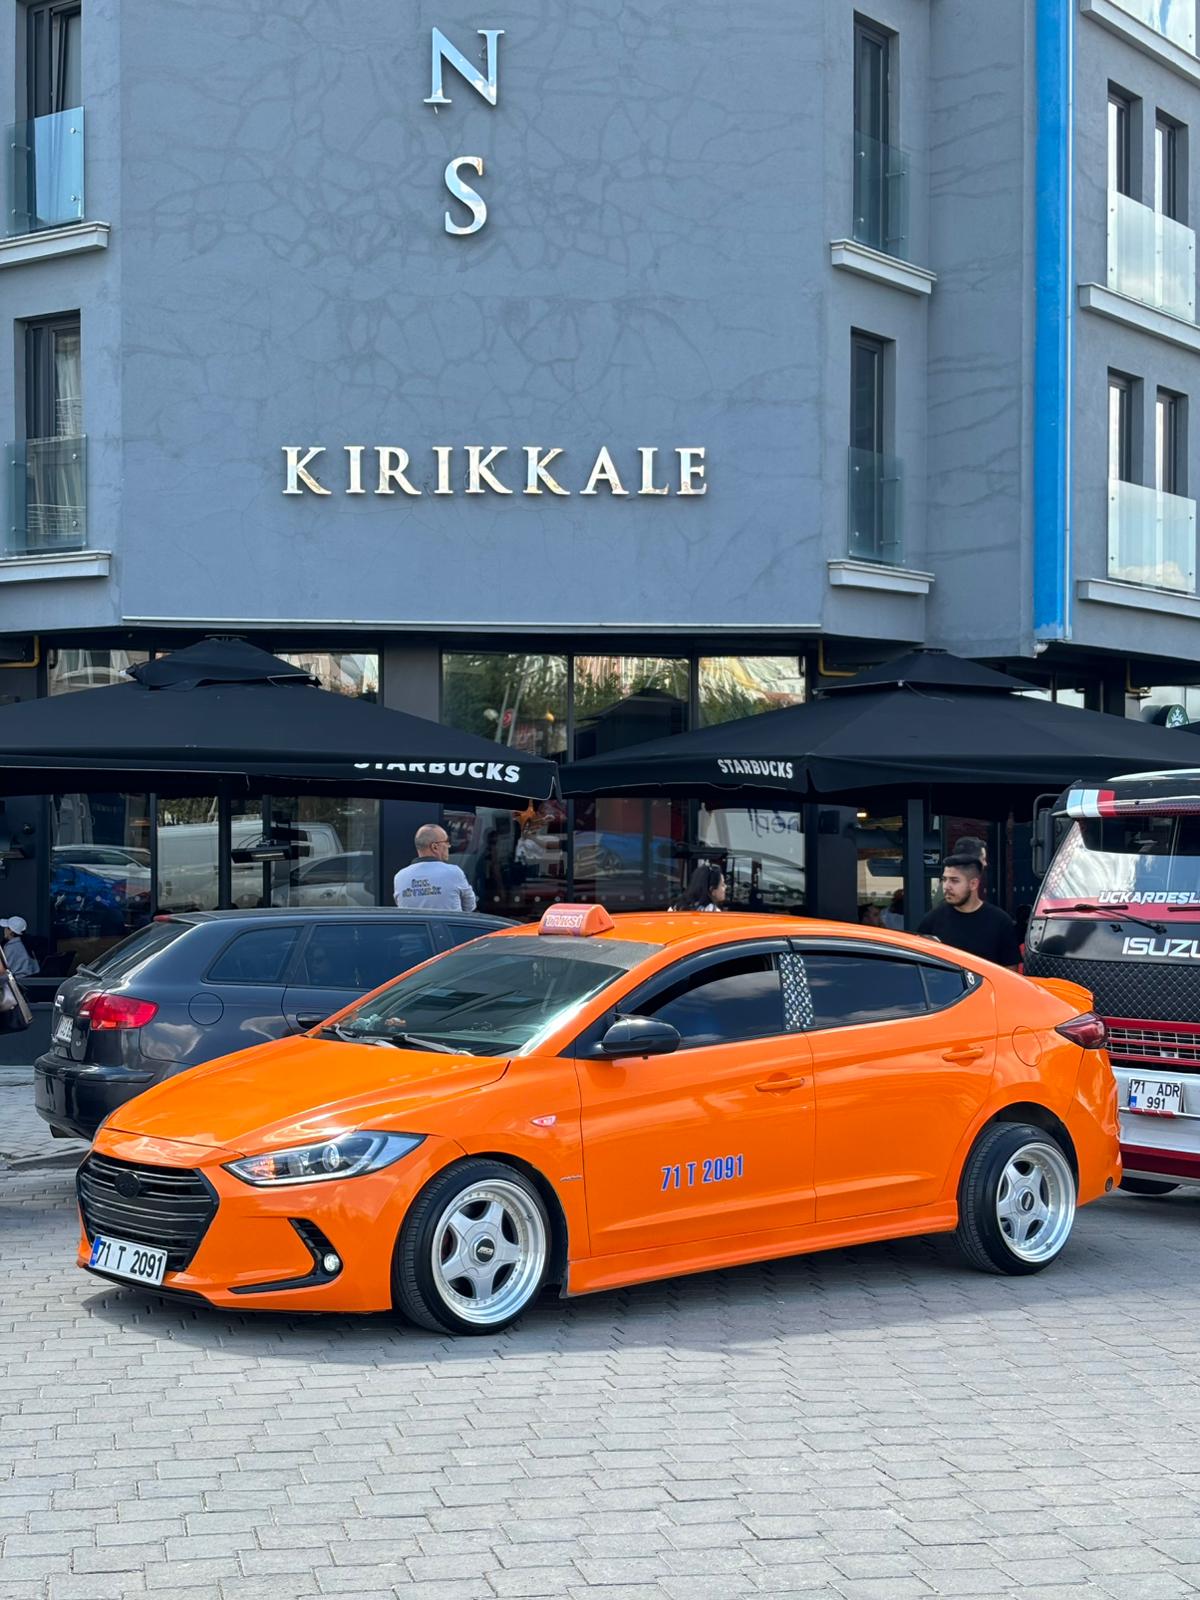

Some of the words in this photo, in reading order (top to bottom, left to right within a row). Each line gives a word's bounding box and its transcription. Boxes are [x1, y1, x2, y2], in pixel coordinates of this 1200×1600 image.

[282, 446, 707, 495] KIRIKKALE
[353, 762, 521, 783] RBUCKS
[717, 758, 794, 779] STARBUCKS
[1098, 891, 1200, 905] UCKARDESL
[1133, 1081, 1145, 1094] 71
[1156, 1084, 1180, 1098] ADR
[1146, 1096, 1166, 1110] 991
[661, 1166, 681, 1191] 71
[686, 1162, 697, 1187] T
[702, 1154, 744, 1184] 2091
[96, 1241, 112, 1267] 71
[117, 1246, 127, 1270] T
[130, 1250, 163, 1280] 2091
